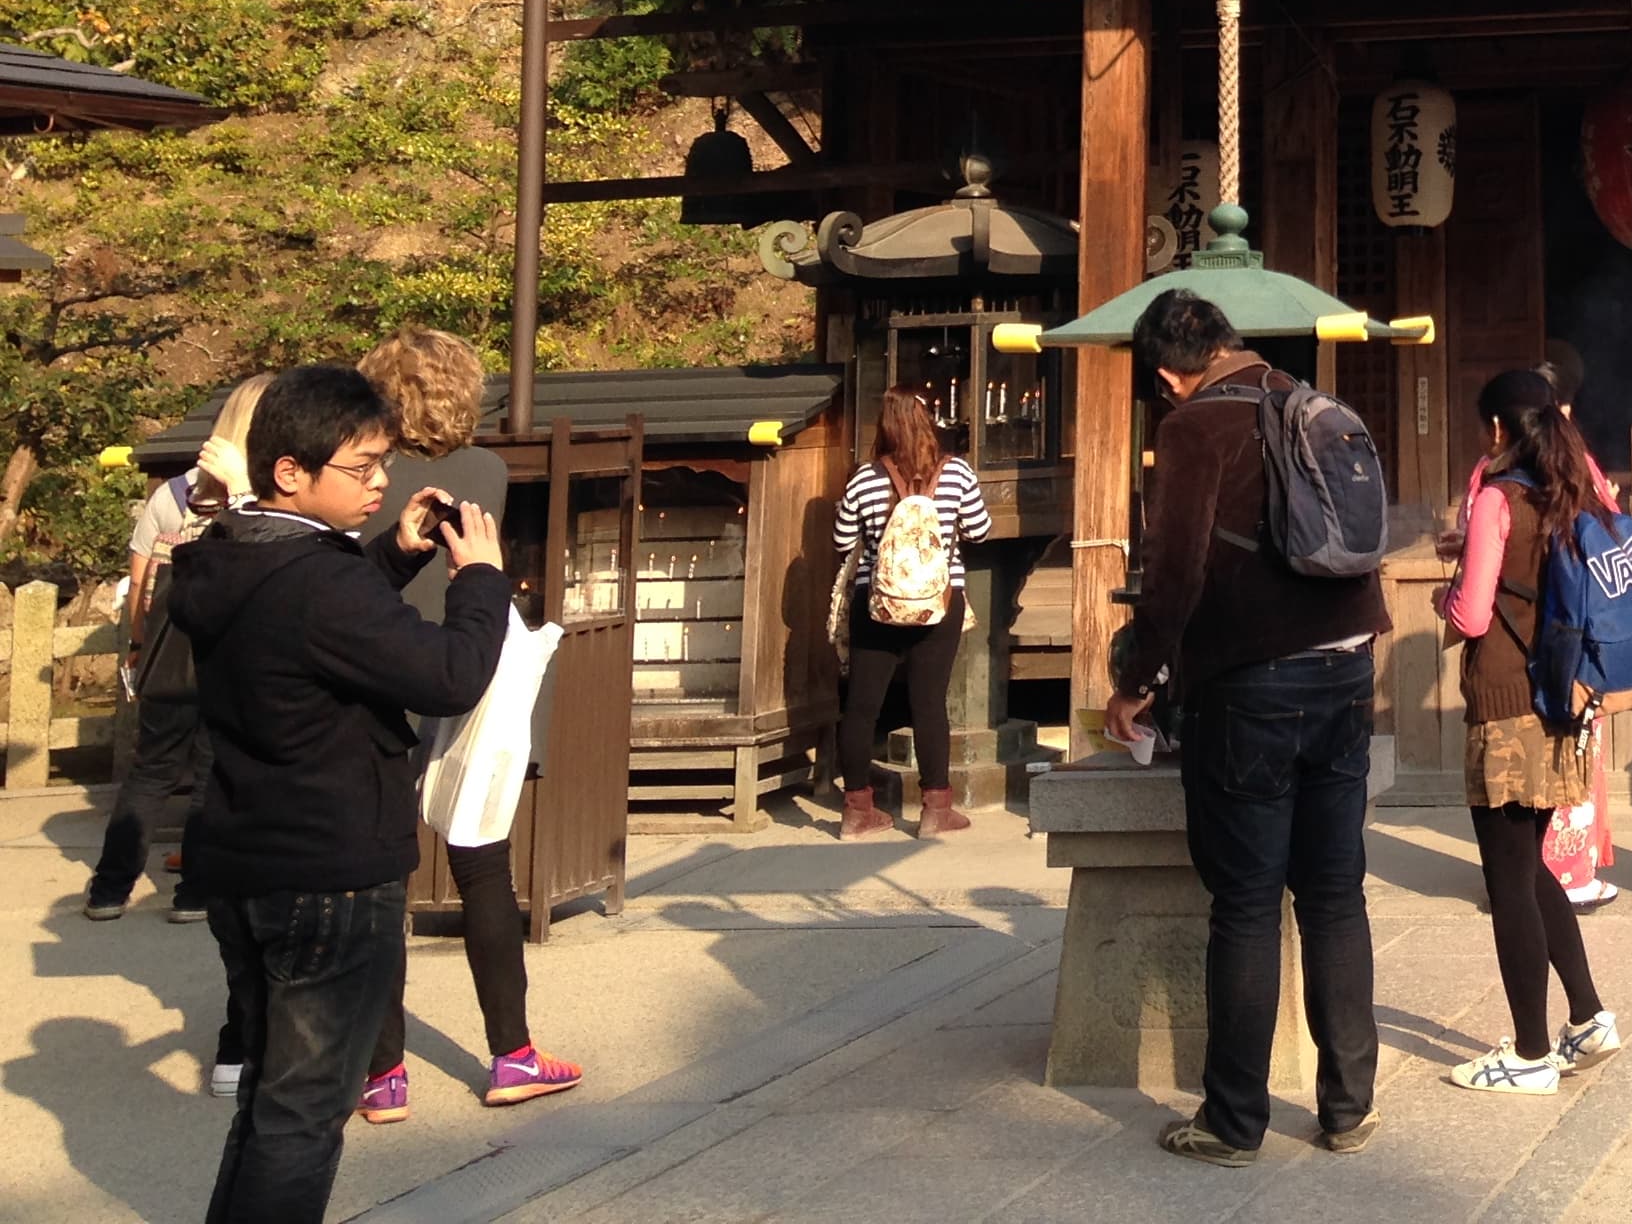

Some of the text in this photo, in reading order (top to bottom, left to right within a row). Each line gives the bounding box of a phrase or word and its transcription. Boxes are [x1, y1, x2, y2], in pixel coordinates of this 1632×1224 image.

[1384, 93, 1423, 218] 石不動明王
